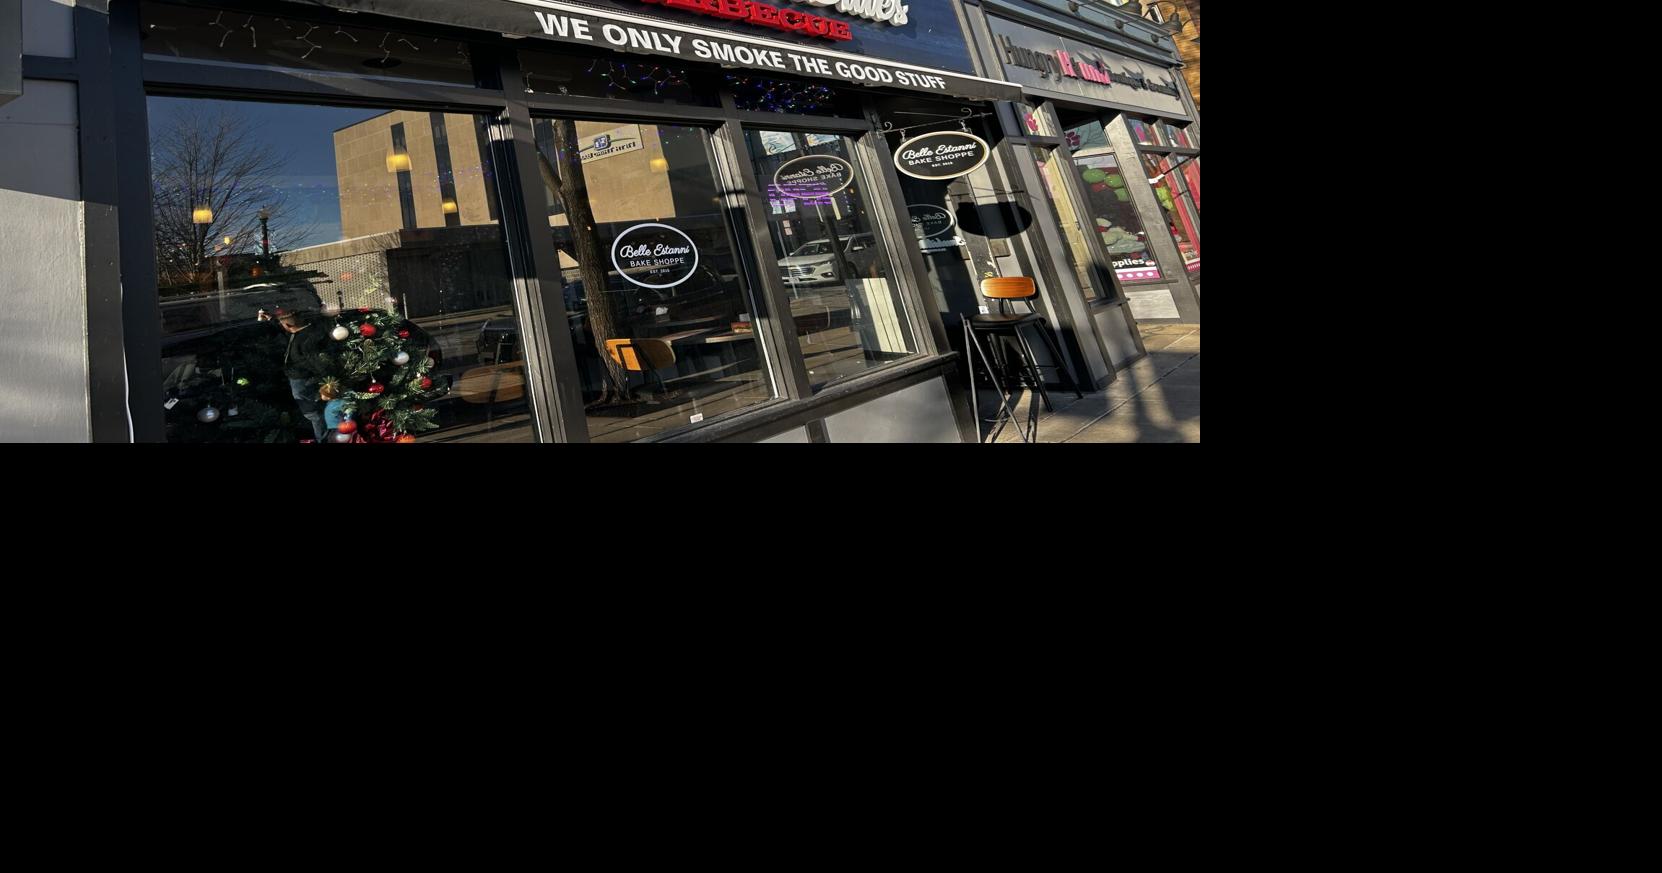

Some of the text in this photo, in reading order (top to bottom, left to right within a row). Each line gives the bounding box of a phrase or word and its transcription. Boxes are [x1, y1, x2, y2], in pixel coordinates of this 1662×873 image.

[534, 11, 946, 90] WE ONLY SMOKE THE GOOD STUFF
[902, 142, 977, 160] Belle Estanni
[908, 151, 975, 166] BAKE SHOPPE
[620, 244, 690, 258] Belle Estanni
[654, 257, 685, 266] SHOPPE
